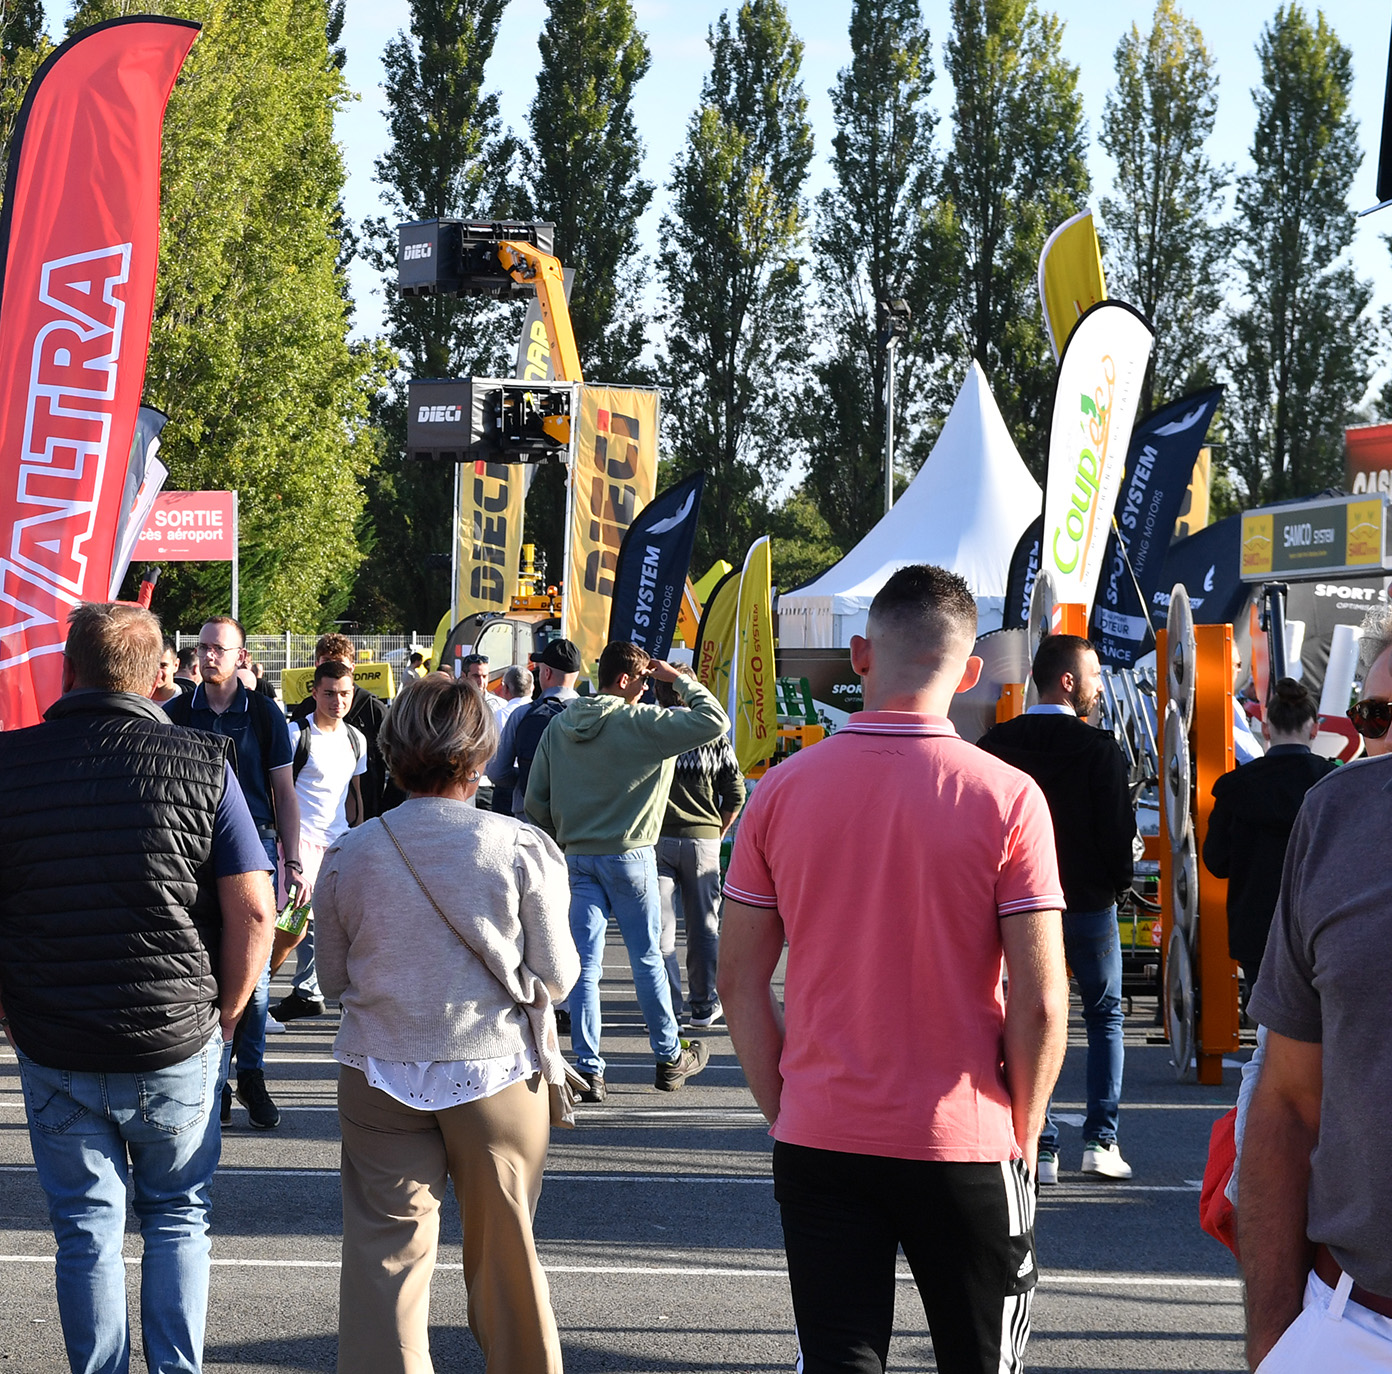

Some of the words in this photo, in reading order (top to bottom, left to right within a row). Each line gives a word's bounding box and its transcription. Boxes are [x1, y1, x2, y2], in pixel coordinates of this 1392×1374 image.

[1121, 444, 1158, 530] SYSTEM
[155, 510, 223, 527] SORTIE
[1142, 489, 1164, 539] MOTORS
[139, 528, 162, 541] cès
[167, 528, 223, 543] aéroport
[1283, 523, 1312, 548] SAMCO
[634, 545, 661, 628] SYSTEM
[1314, 583, 1376, 600] SPORT
[659, 584, 674, 633] MOTORS
[1100, 619, 1129, 634] OTEUR
[753, 603, 761, 652] SYSTEM
[353, 671, 381, 681] DNAR
[700, 640, 714, 688] SAMC
[751, 656, 767, 740] SAMCO
[832, 684, 862, 694] SPOR
